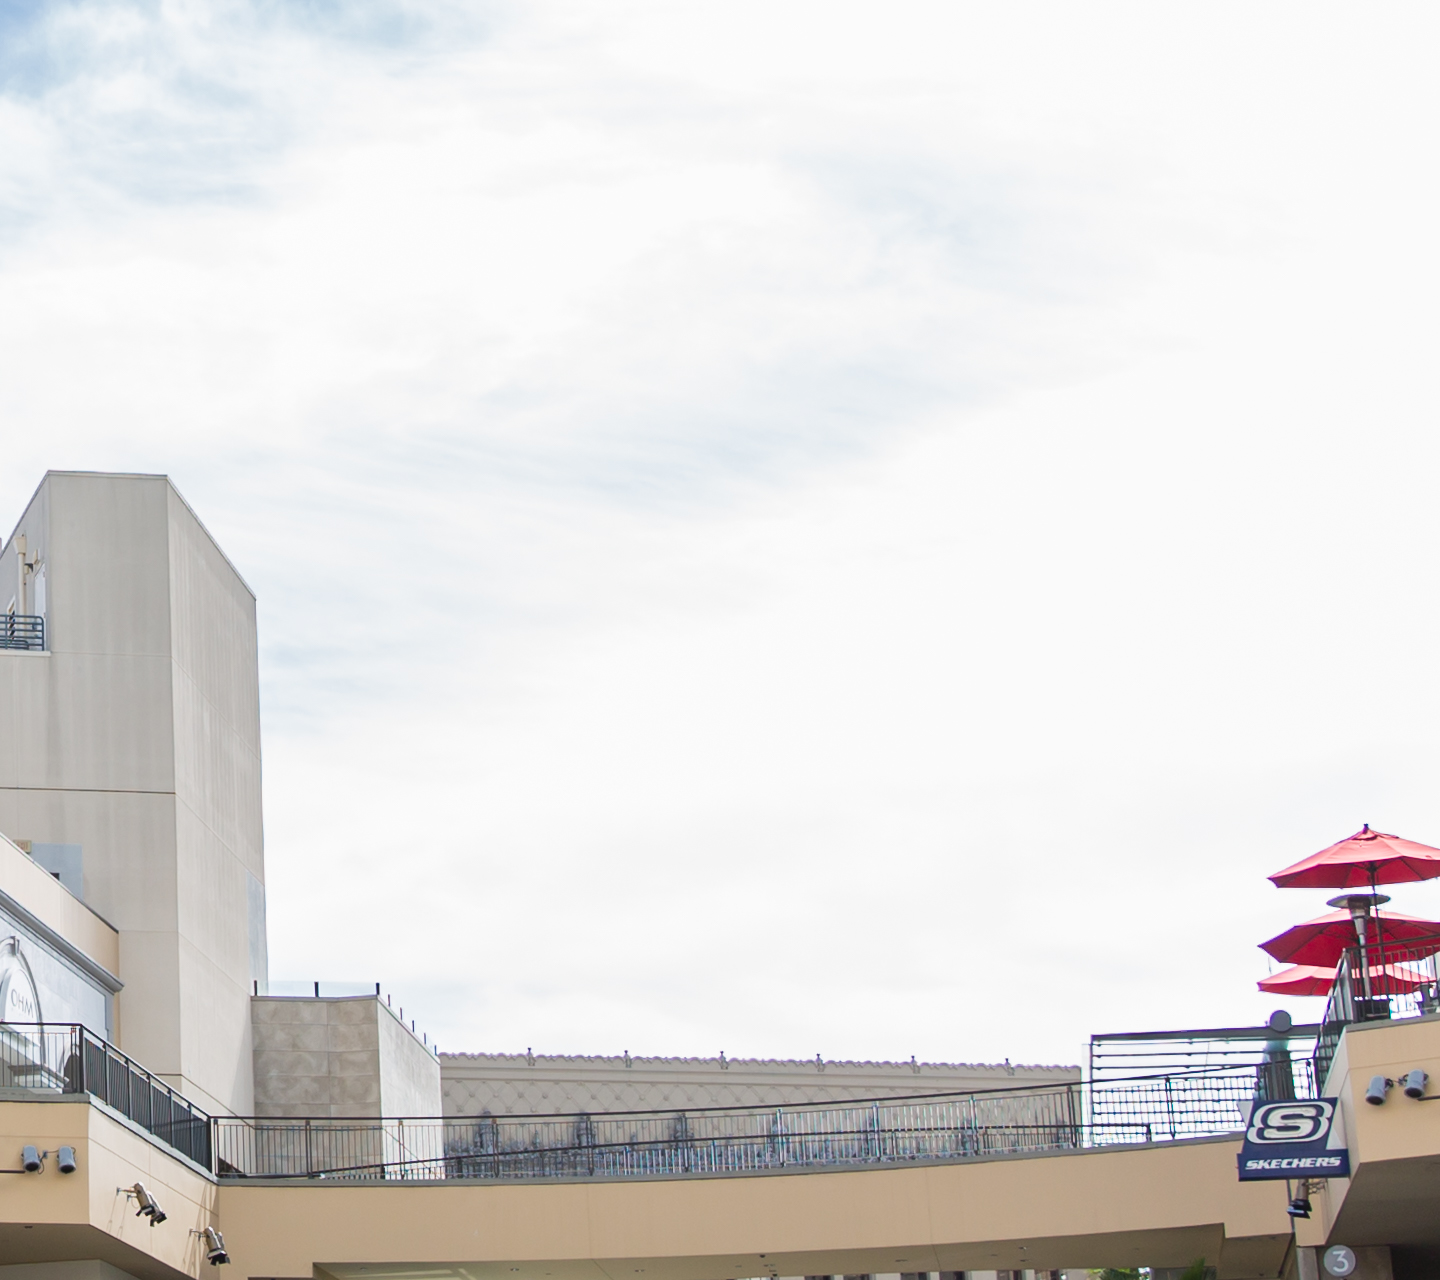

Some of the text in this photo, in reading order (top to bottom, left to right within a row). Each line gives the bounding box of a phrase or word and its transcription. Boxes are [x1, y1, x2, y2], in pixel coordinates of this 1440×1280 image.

[10, 988, 34, 1018] OHM
[1245, 1156, 1342, 1170] SKECHERS
[1332, 1249, 1349, 1273] 3
